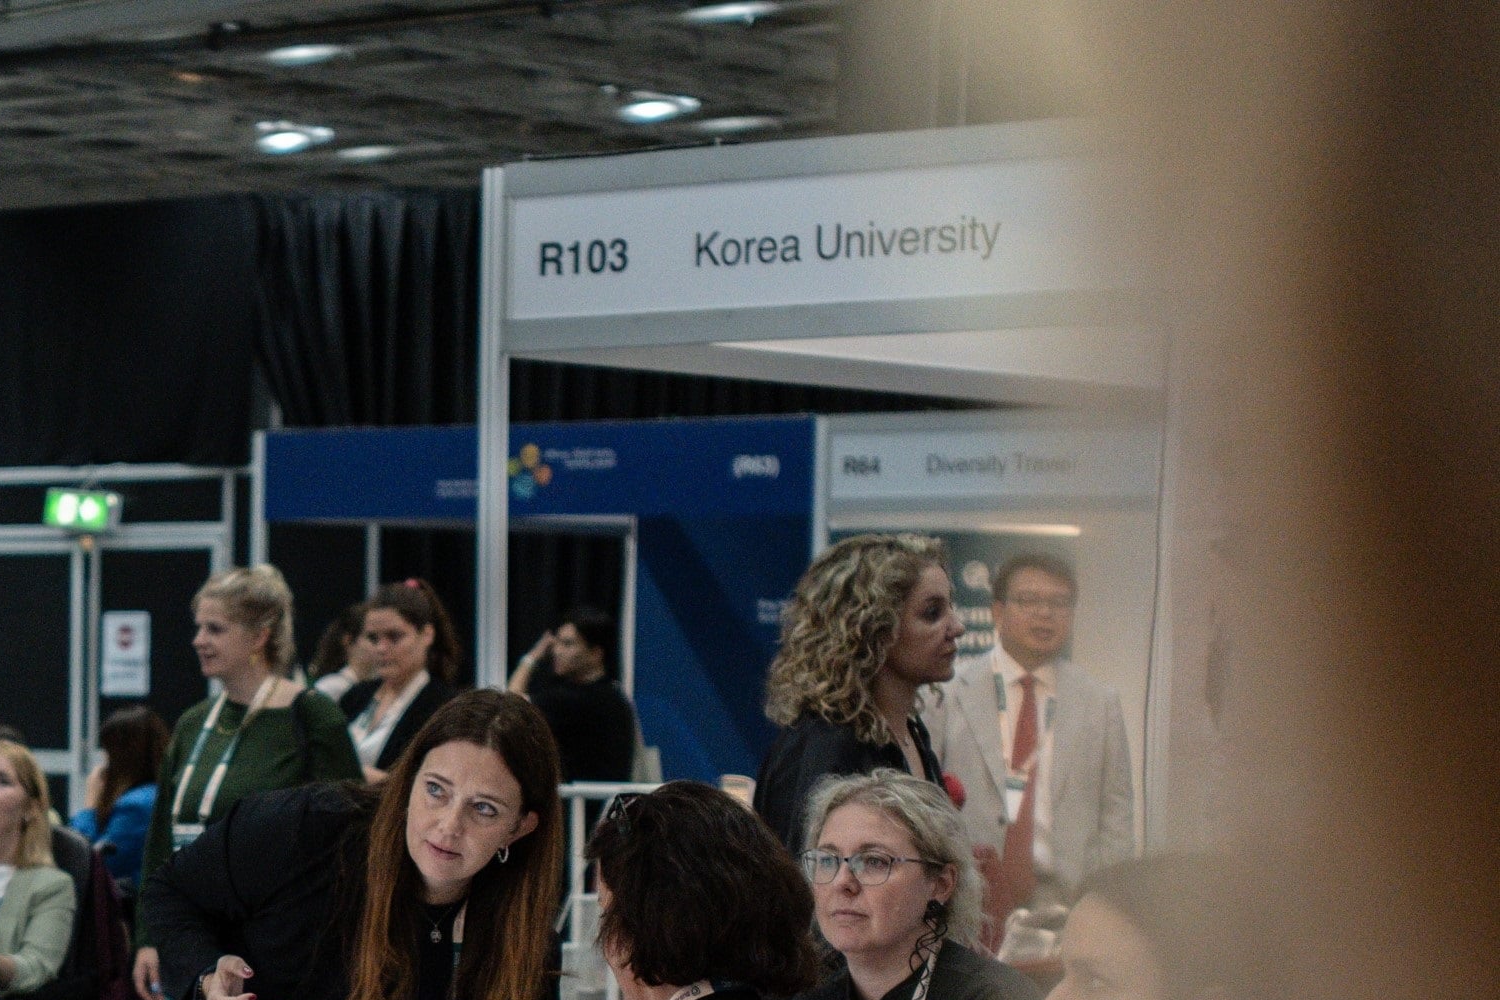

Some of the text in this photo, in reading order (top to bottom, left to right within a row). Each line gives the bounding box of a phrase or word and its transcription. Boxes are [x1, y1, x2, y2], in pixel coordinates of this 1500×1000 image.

[539, 213, 1002, 276] R103 Korea University
